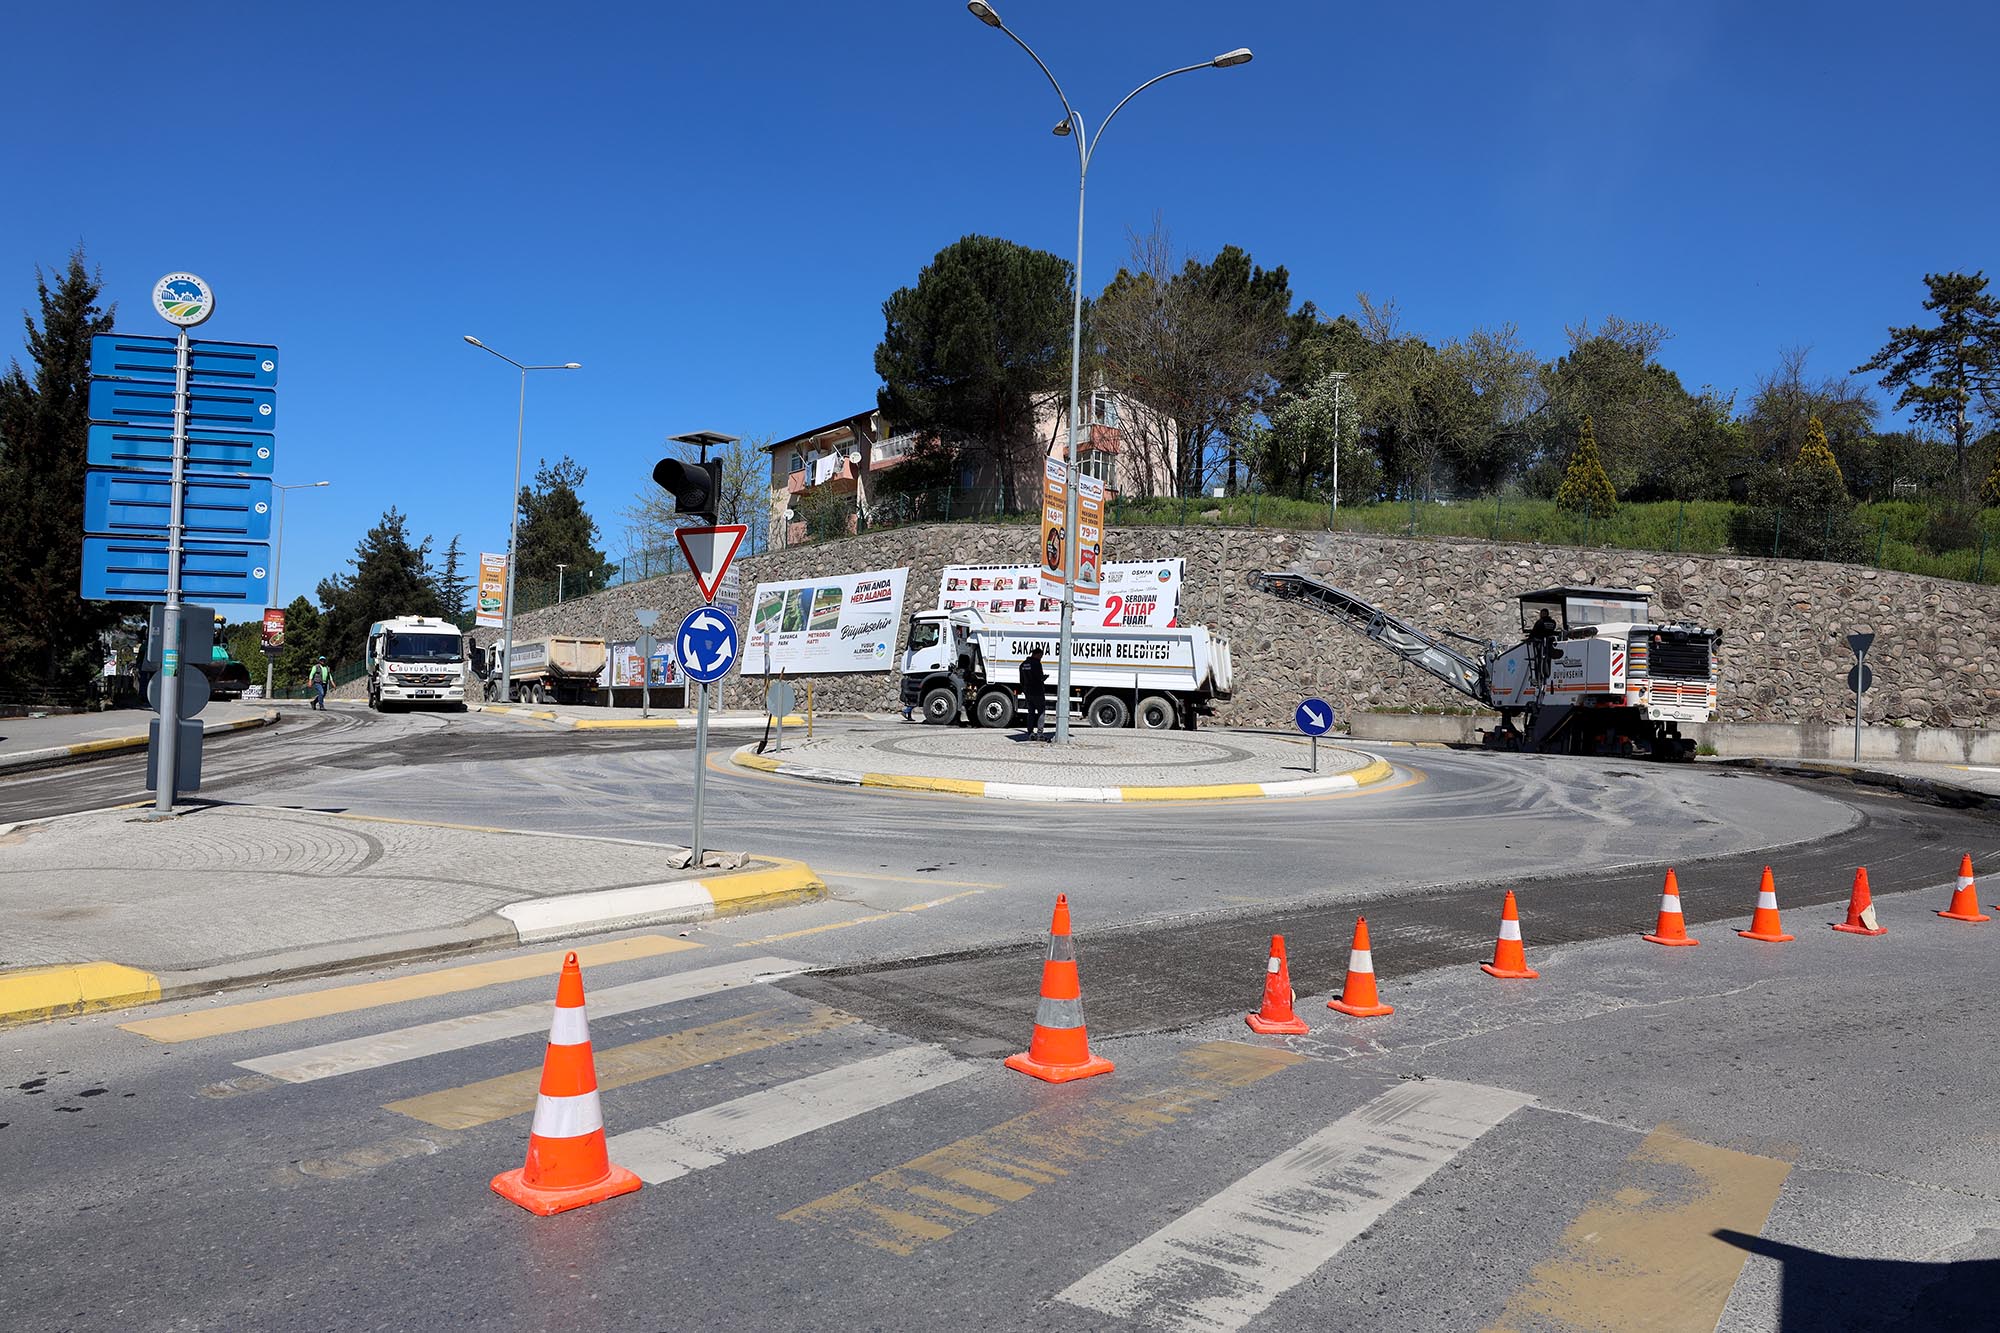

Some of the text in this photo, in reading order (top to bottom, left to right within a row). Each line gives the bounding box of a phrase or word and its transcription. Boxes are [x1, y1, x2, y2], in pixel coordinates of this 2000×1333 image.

[855, 579, 891, 594] AYNI ANDA
[850, 588, 892, 603] HER ALANDA
[1122, 615, 1147, 625] FUARI
[840, 617, 892, 640] Büyükşehir
[1055, 639, 1112, 659] BÜKŞEHİR
[1116, 640, 1170, 660] BELEDİYESİ
